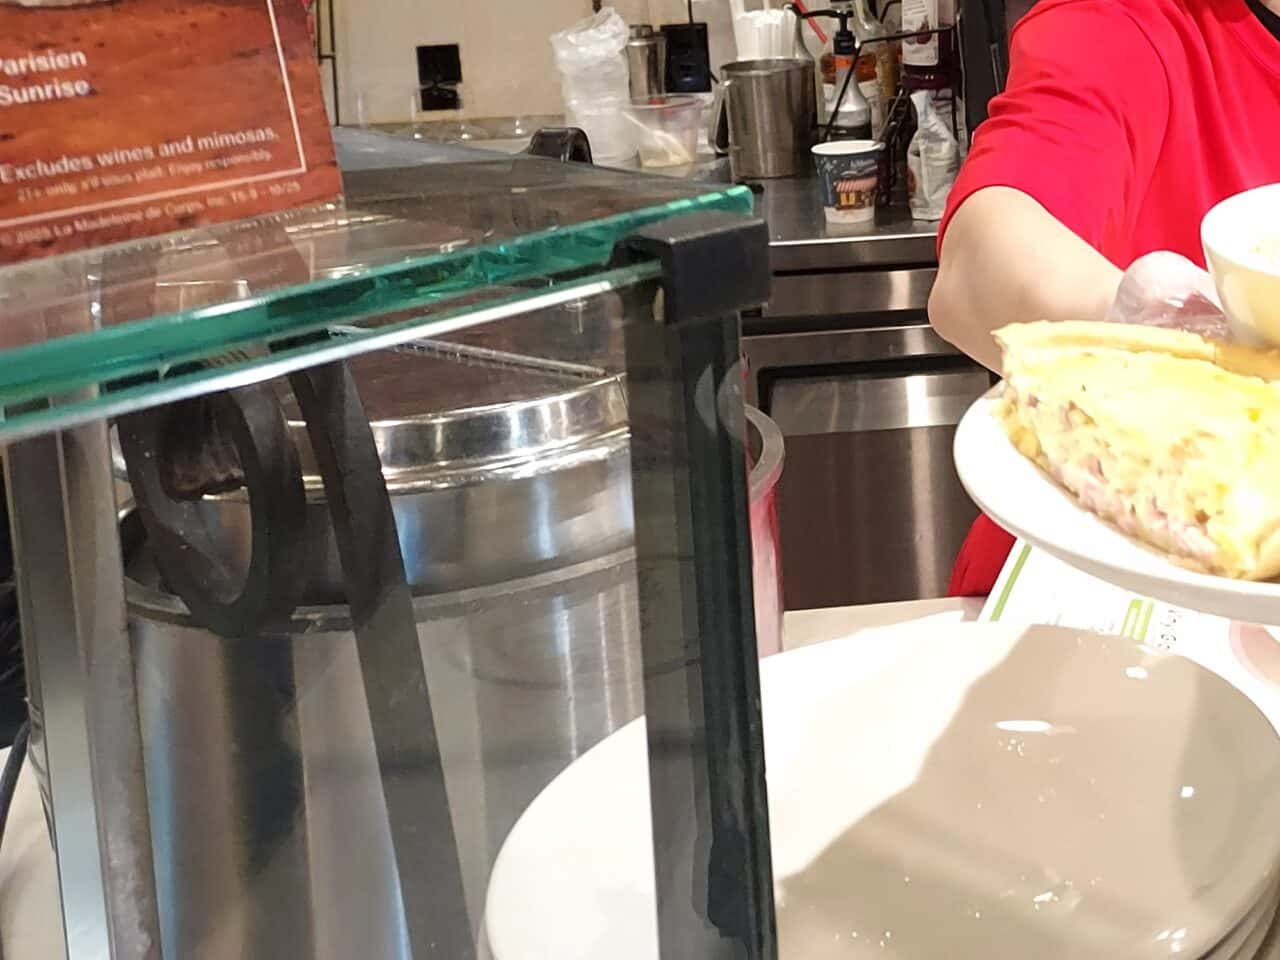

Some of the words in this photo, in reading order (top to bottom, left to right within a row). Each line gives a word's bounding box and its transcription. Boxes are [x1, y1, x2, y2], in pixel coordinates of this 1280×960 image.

[0, 49, 87, 76] arisien
[0, 154, 94, 184] Excludes
[96, 145, 154, 167] wines
[158, 135, 195, 158] and
